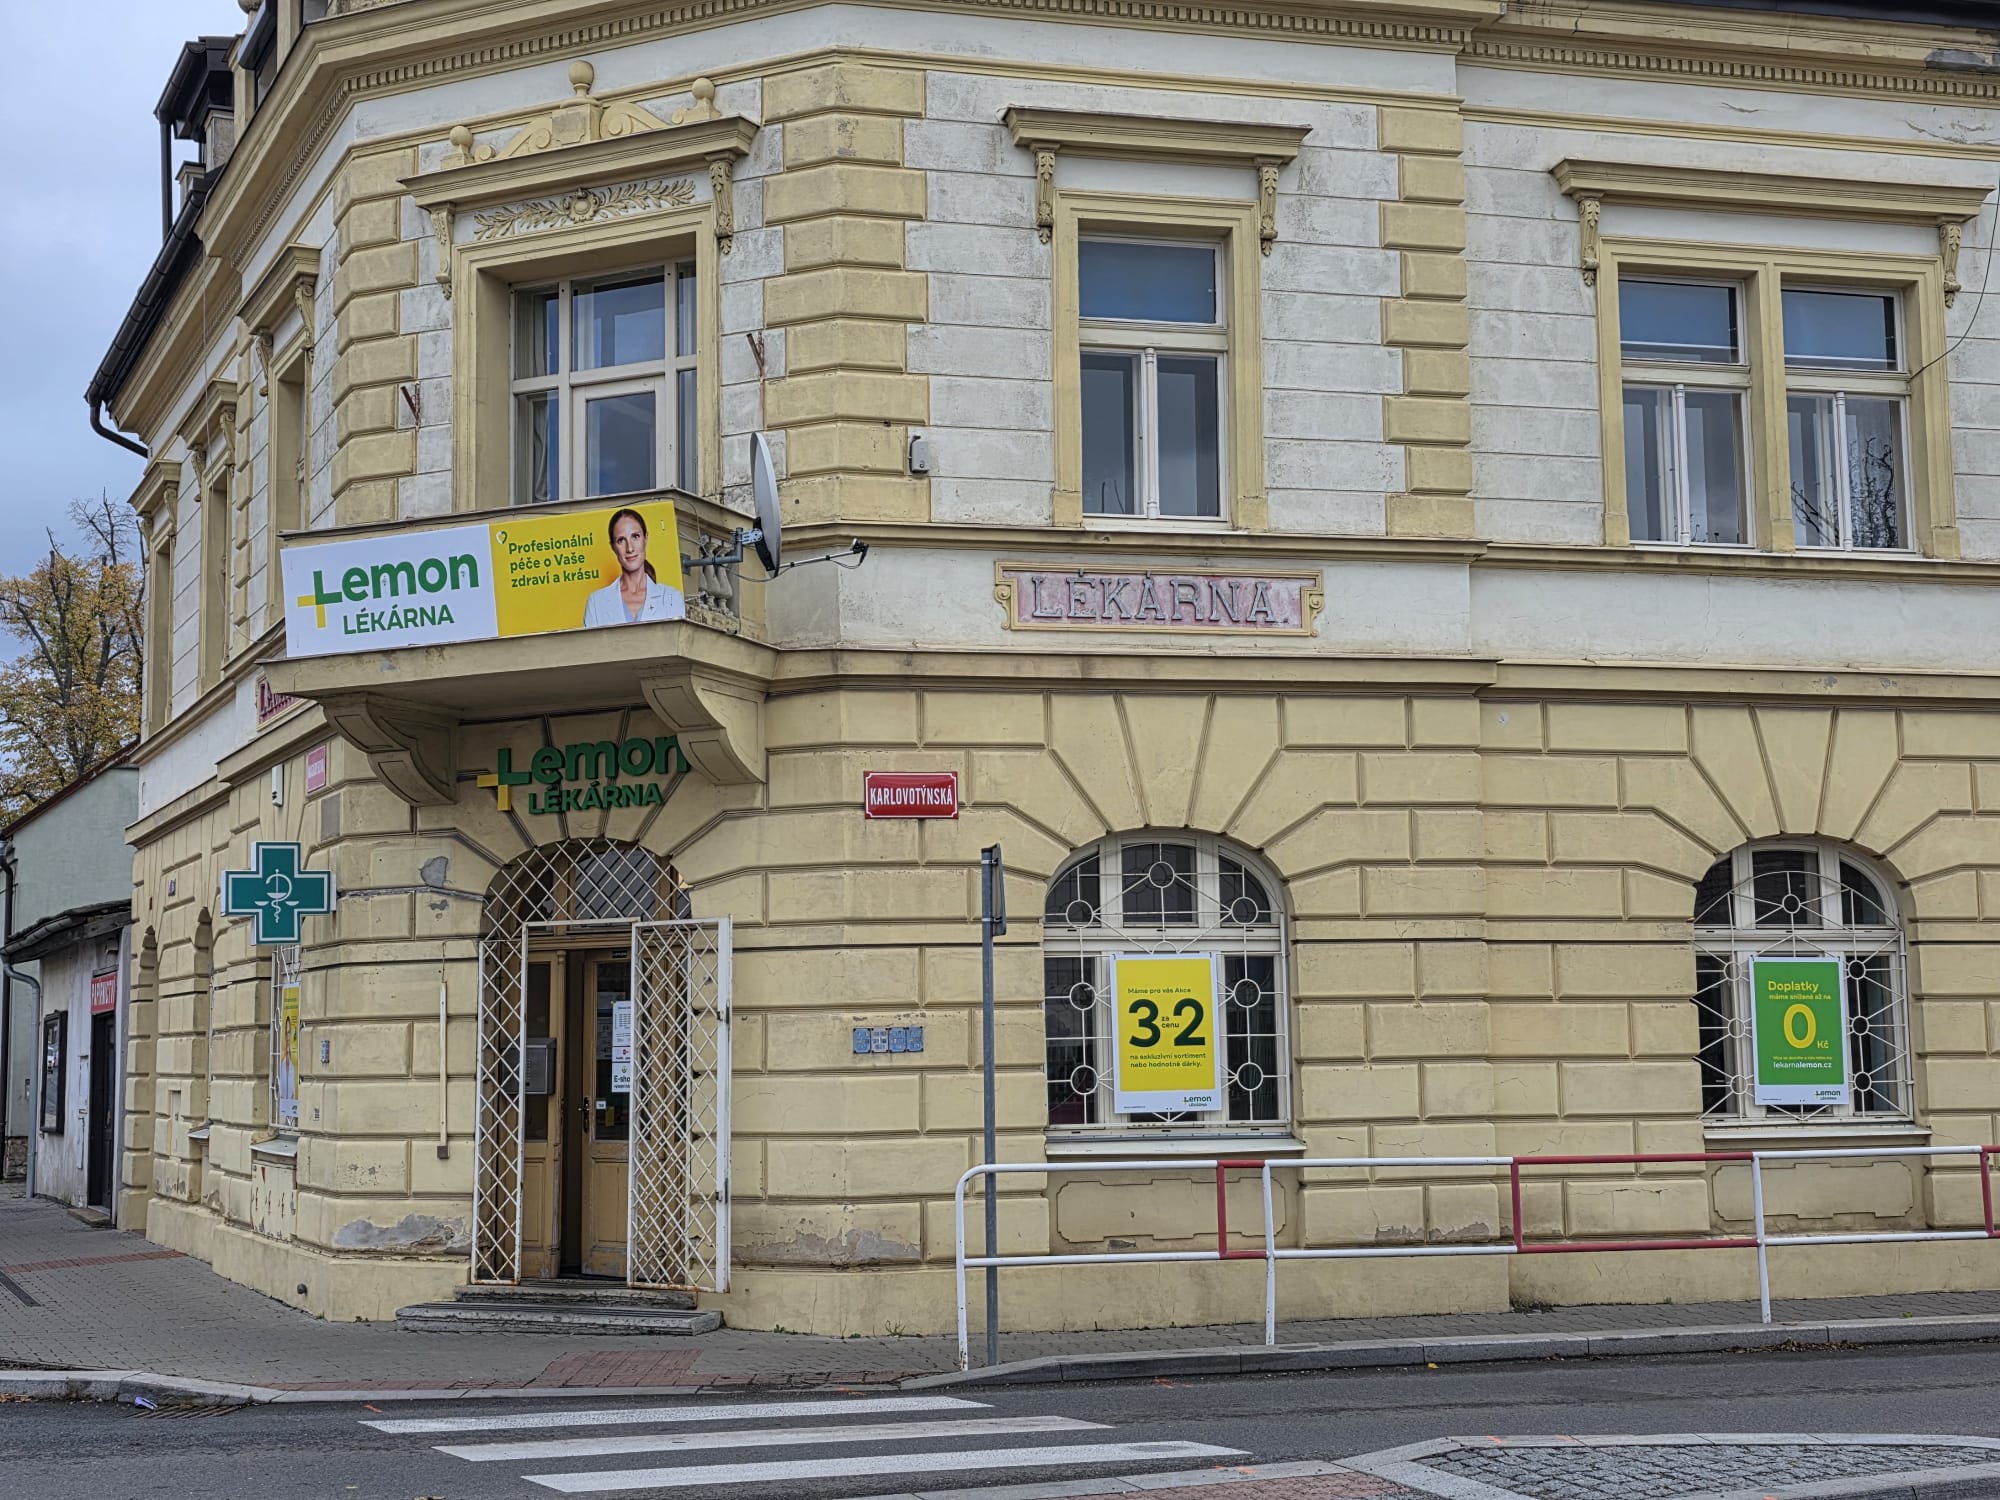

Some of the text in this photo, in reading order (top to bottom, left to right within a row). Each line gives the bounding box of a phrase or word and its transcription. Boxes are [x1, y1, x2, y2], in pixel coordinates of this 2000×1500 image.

[508, 532, 594, 555] Profesionální
[509, 550, 585, 573] péče o Vaše
[312, 552, 480, 606] Lemon
[510, 566, 600, 588] zdraví a krásu
[342, 603, 455, 636] LÉKÁRNA
[528, 780, 665, 815] LÉKÁRNA
[870, 784, 953, 805] KARLOVOTÝNSKÁ
[1768, 980, 1819, 993] Doplatky
[1129, 998, 1160, 1047] 3
[1173, 998, 1205, 1046] 2
[1783, 1003, 1830, 1049] 0 Kč
[1148, 1060, 1181, 1068] hodnotné
[1181, 1060, 1202, 1069] dárky.
[1173, 1052, 1206, 1060] sortiment
[1773, 1061, 1832, 1069] lekarnalemon.cz
[613, 1075, 630, 1083] E-sho
[1184, 1095, 1212, 1103] Lemon
